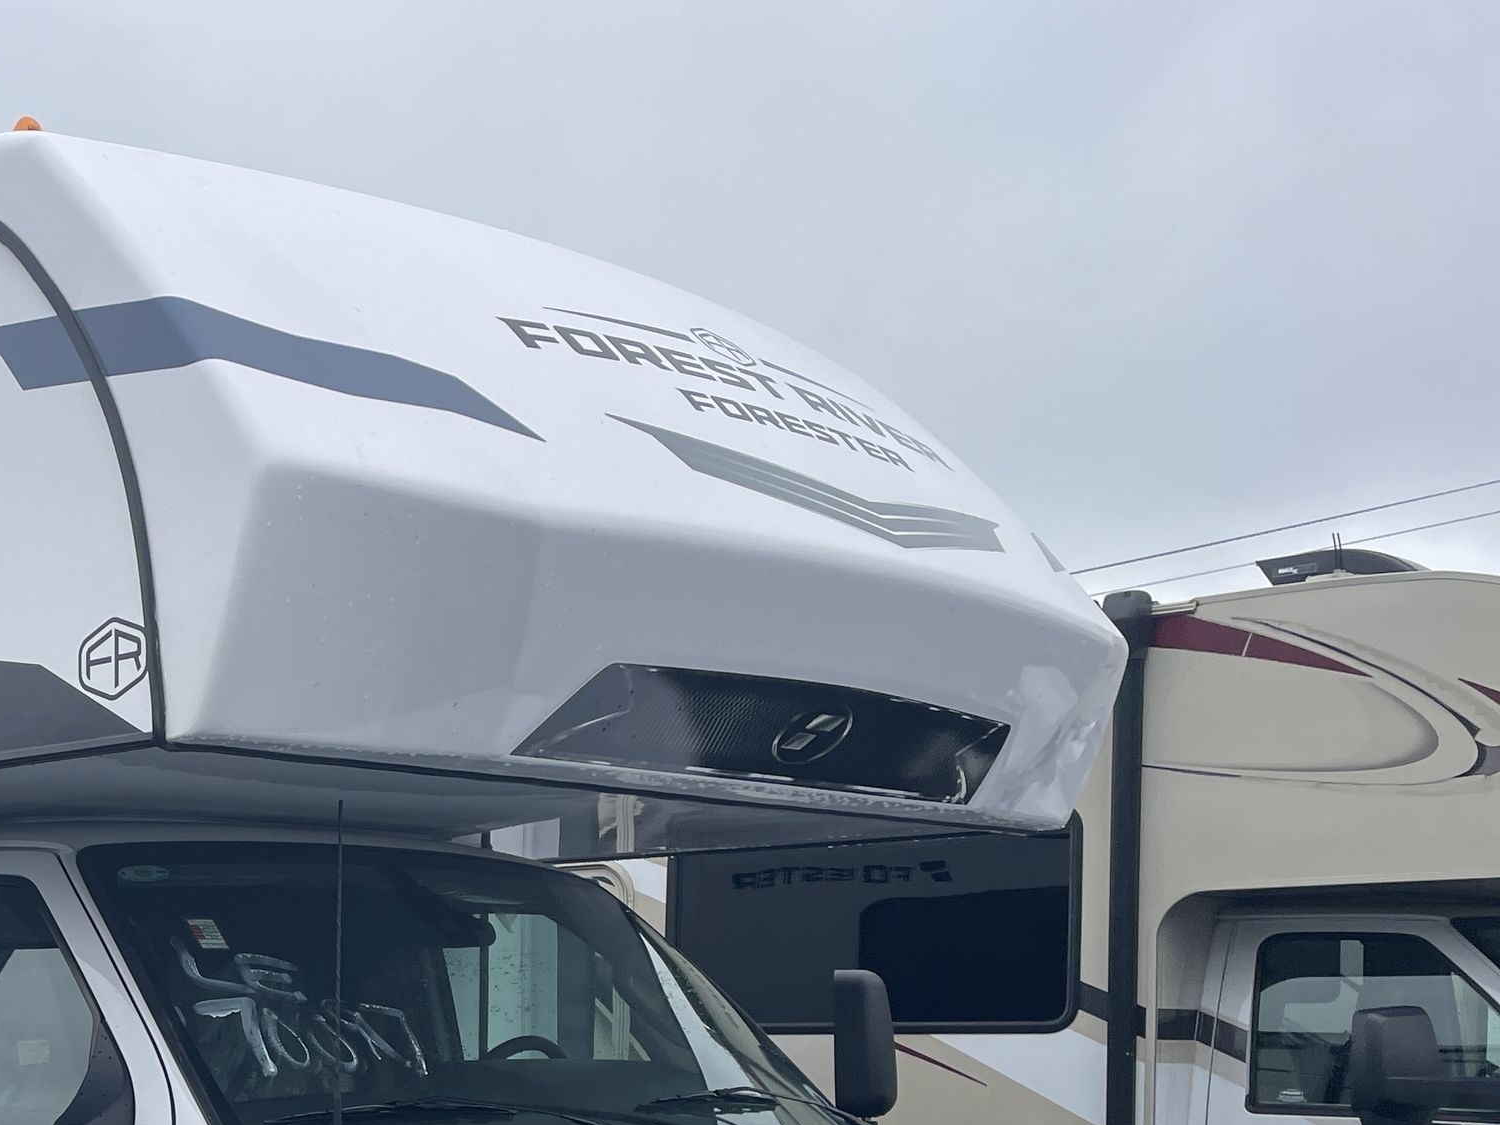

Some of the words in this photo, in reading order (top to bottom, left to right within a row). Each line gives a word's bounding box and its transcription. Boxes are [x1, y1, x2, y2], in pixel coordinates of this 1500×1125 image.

[495, 316, 785, 400] FOREST
[784, 382, 956, 473] RIVER
[675, 387, 916, 473] FORESTER
